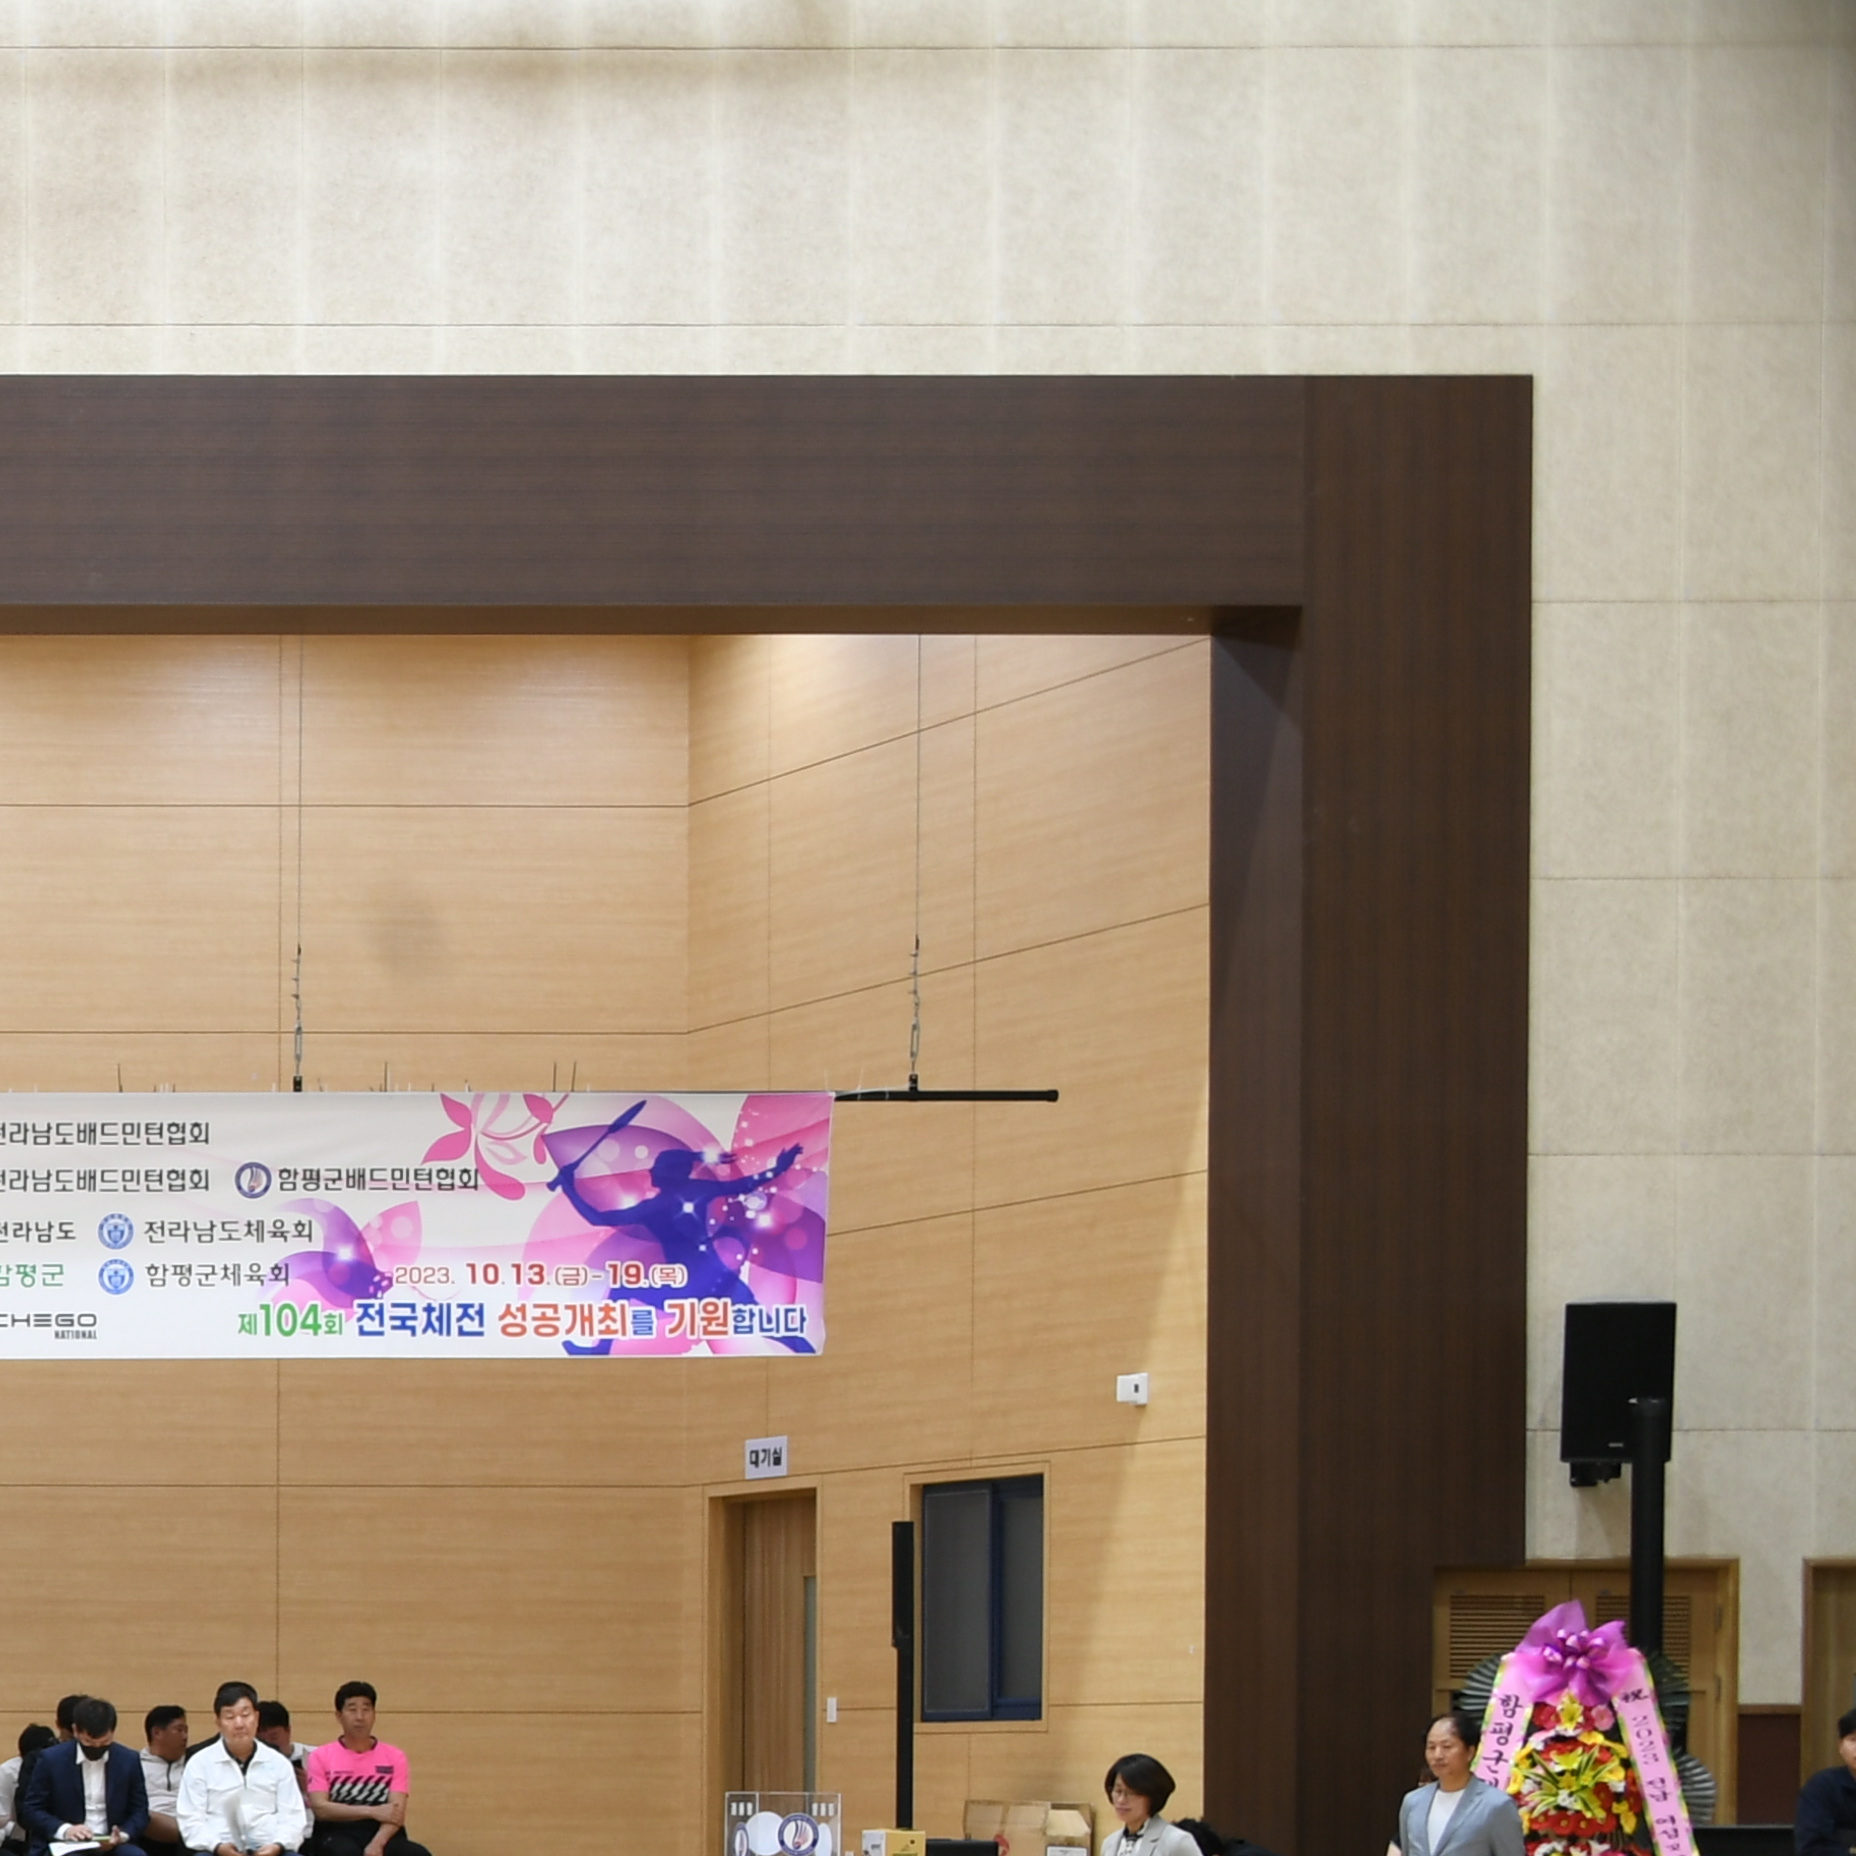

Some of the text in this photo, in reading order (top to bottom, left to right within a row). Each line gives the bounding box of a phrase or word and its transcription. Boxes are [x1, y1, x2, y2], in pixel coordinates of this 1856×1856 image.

[277, 1167, 479, 1192] 함평군배드민턴협회
[143, 1220, 314, 1244] 전라남도체육회
[145, 1263, 291, 1288] 함평군체육회
[395, 1266, 456, 1286] 2023.
[238, 1297, 807, 1339] 제104회 전국체전 성공개최를 기원합니다
[54, 1330, 98, 1340] NATIONAL
[749, 1446, 783, 1469] 대기실
